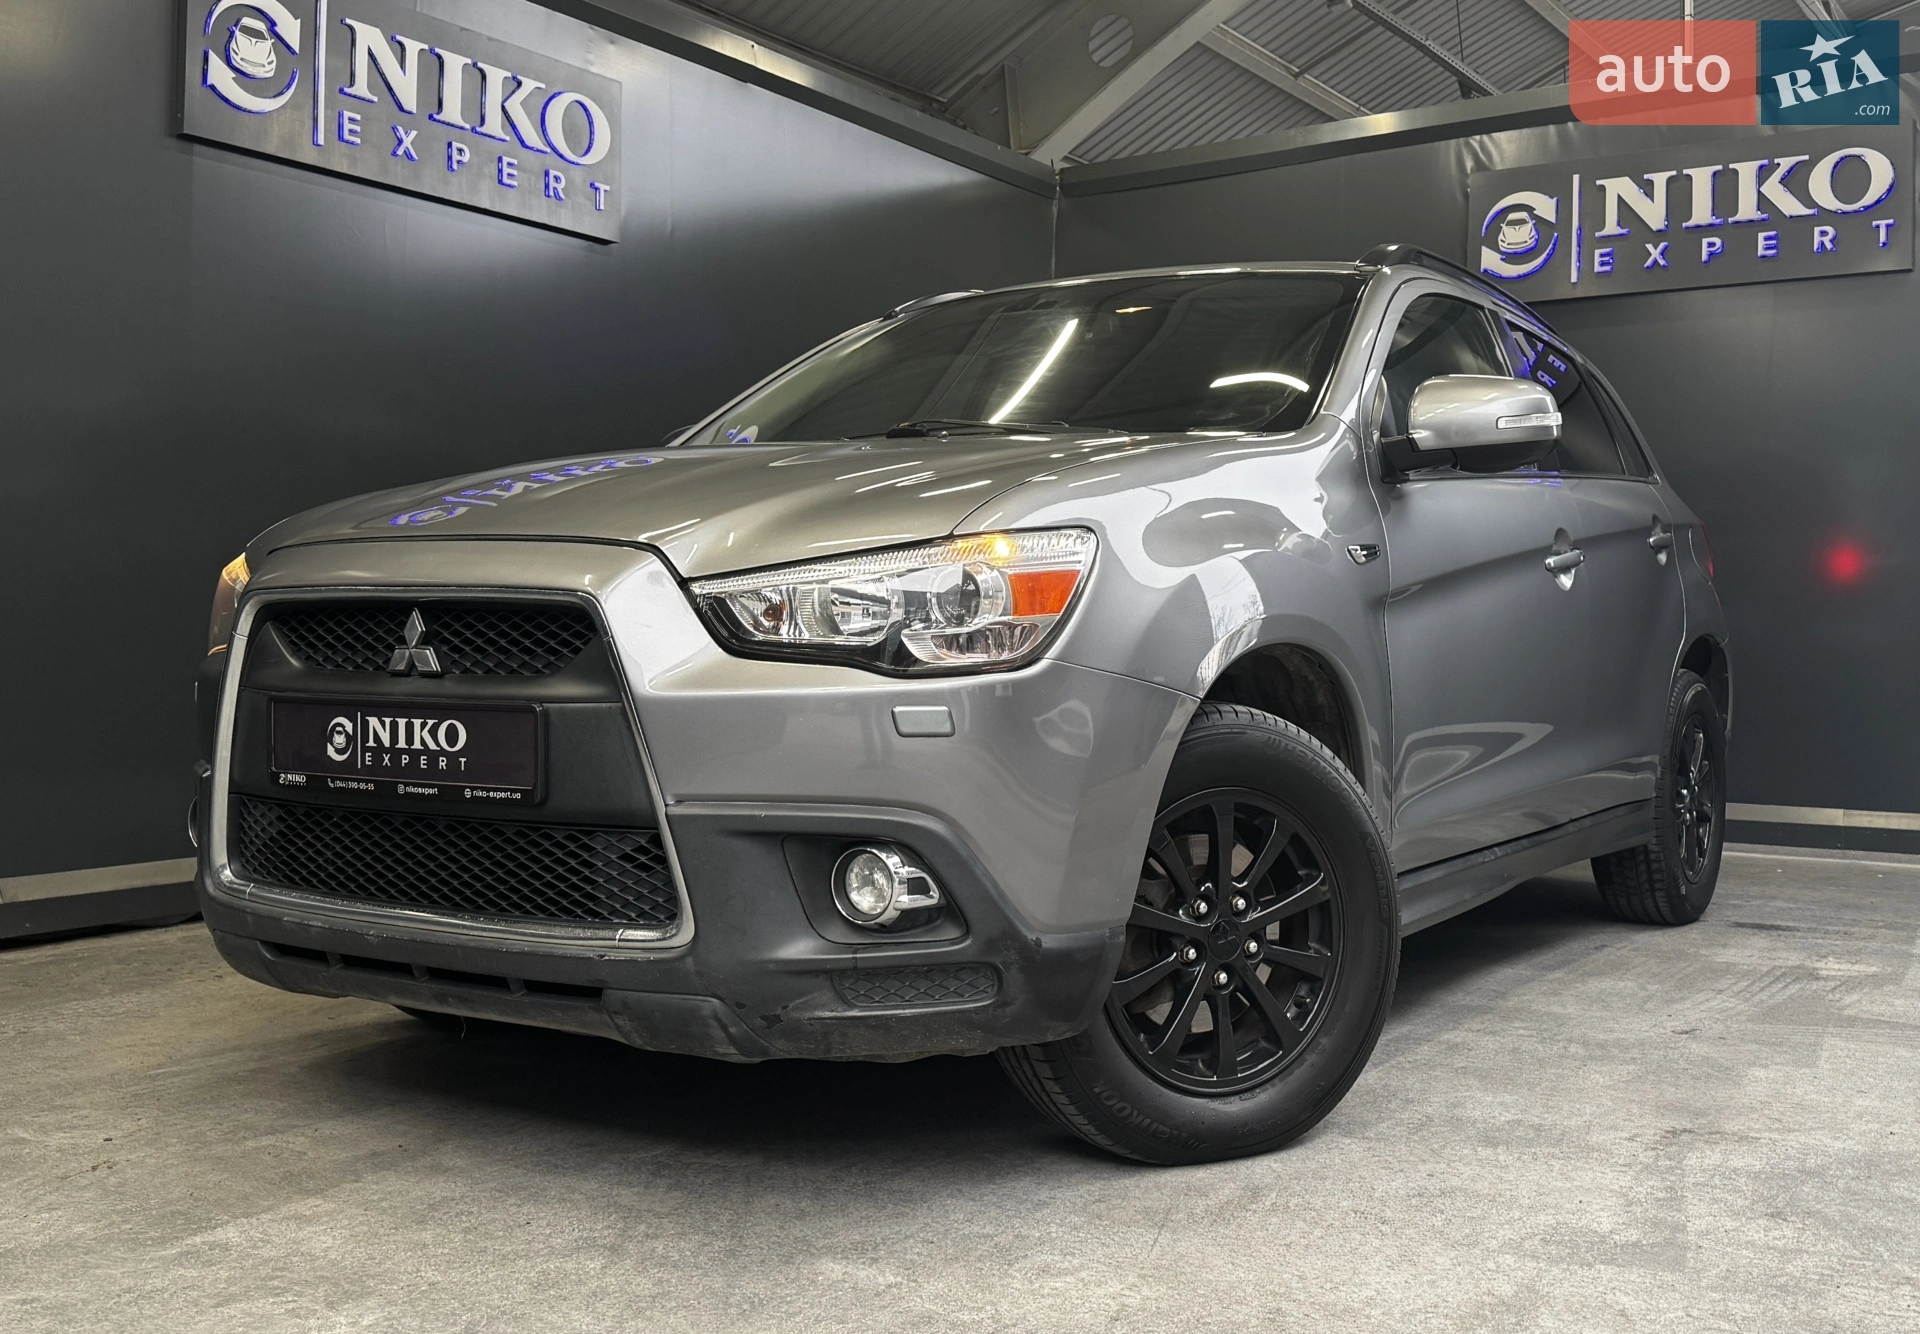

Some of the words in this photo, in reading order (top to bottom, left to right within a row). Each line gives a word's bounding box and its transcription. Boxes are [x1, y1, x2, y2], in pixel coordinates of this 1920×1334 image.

[339, 17, 611, 165] NIKO
[338, 110, 610, 211] EXPERT
[1595, 147, 1896, 238] NIKO
[1594, 219, 1895, 273] EXPERT
[365, 716, 467, 752] NIKO
[365, 752, 467, 771] EXPERT
